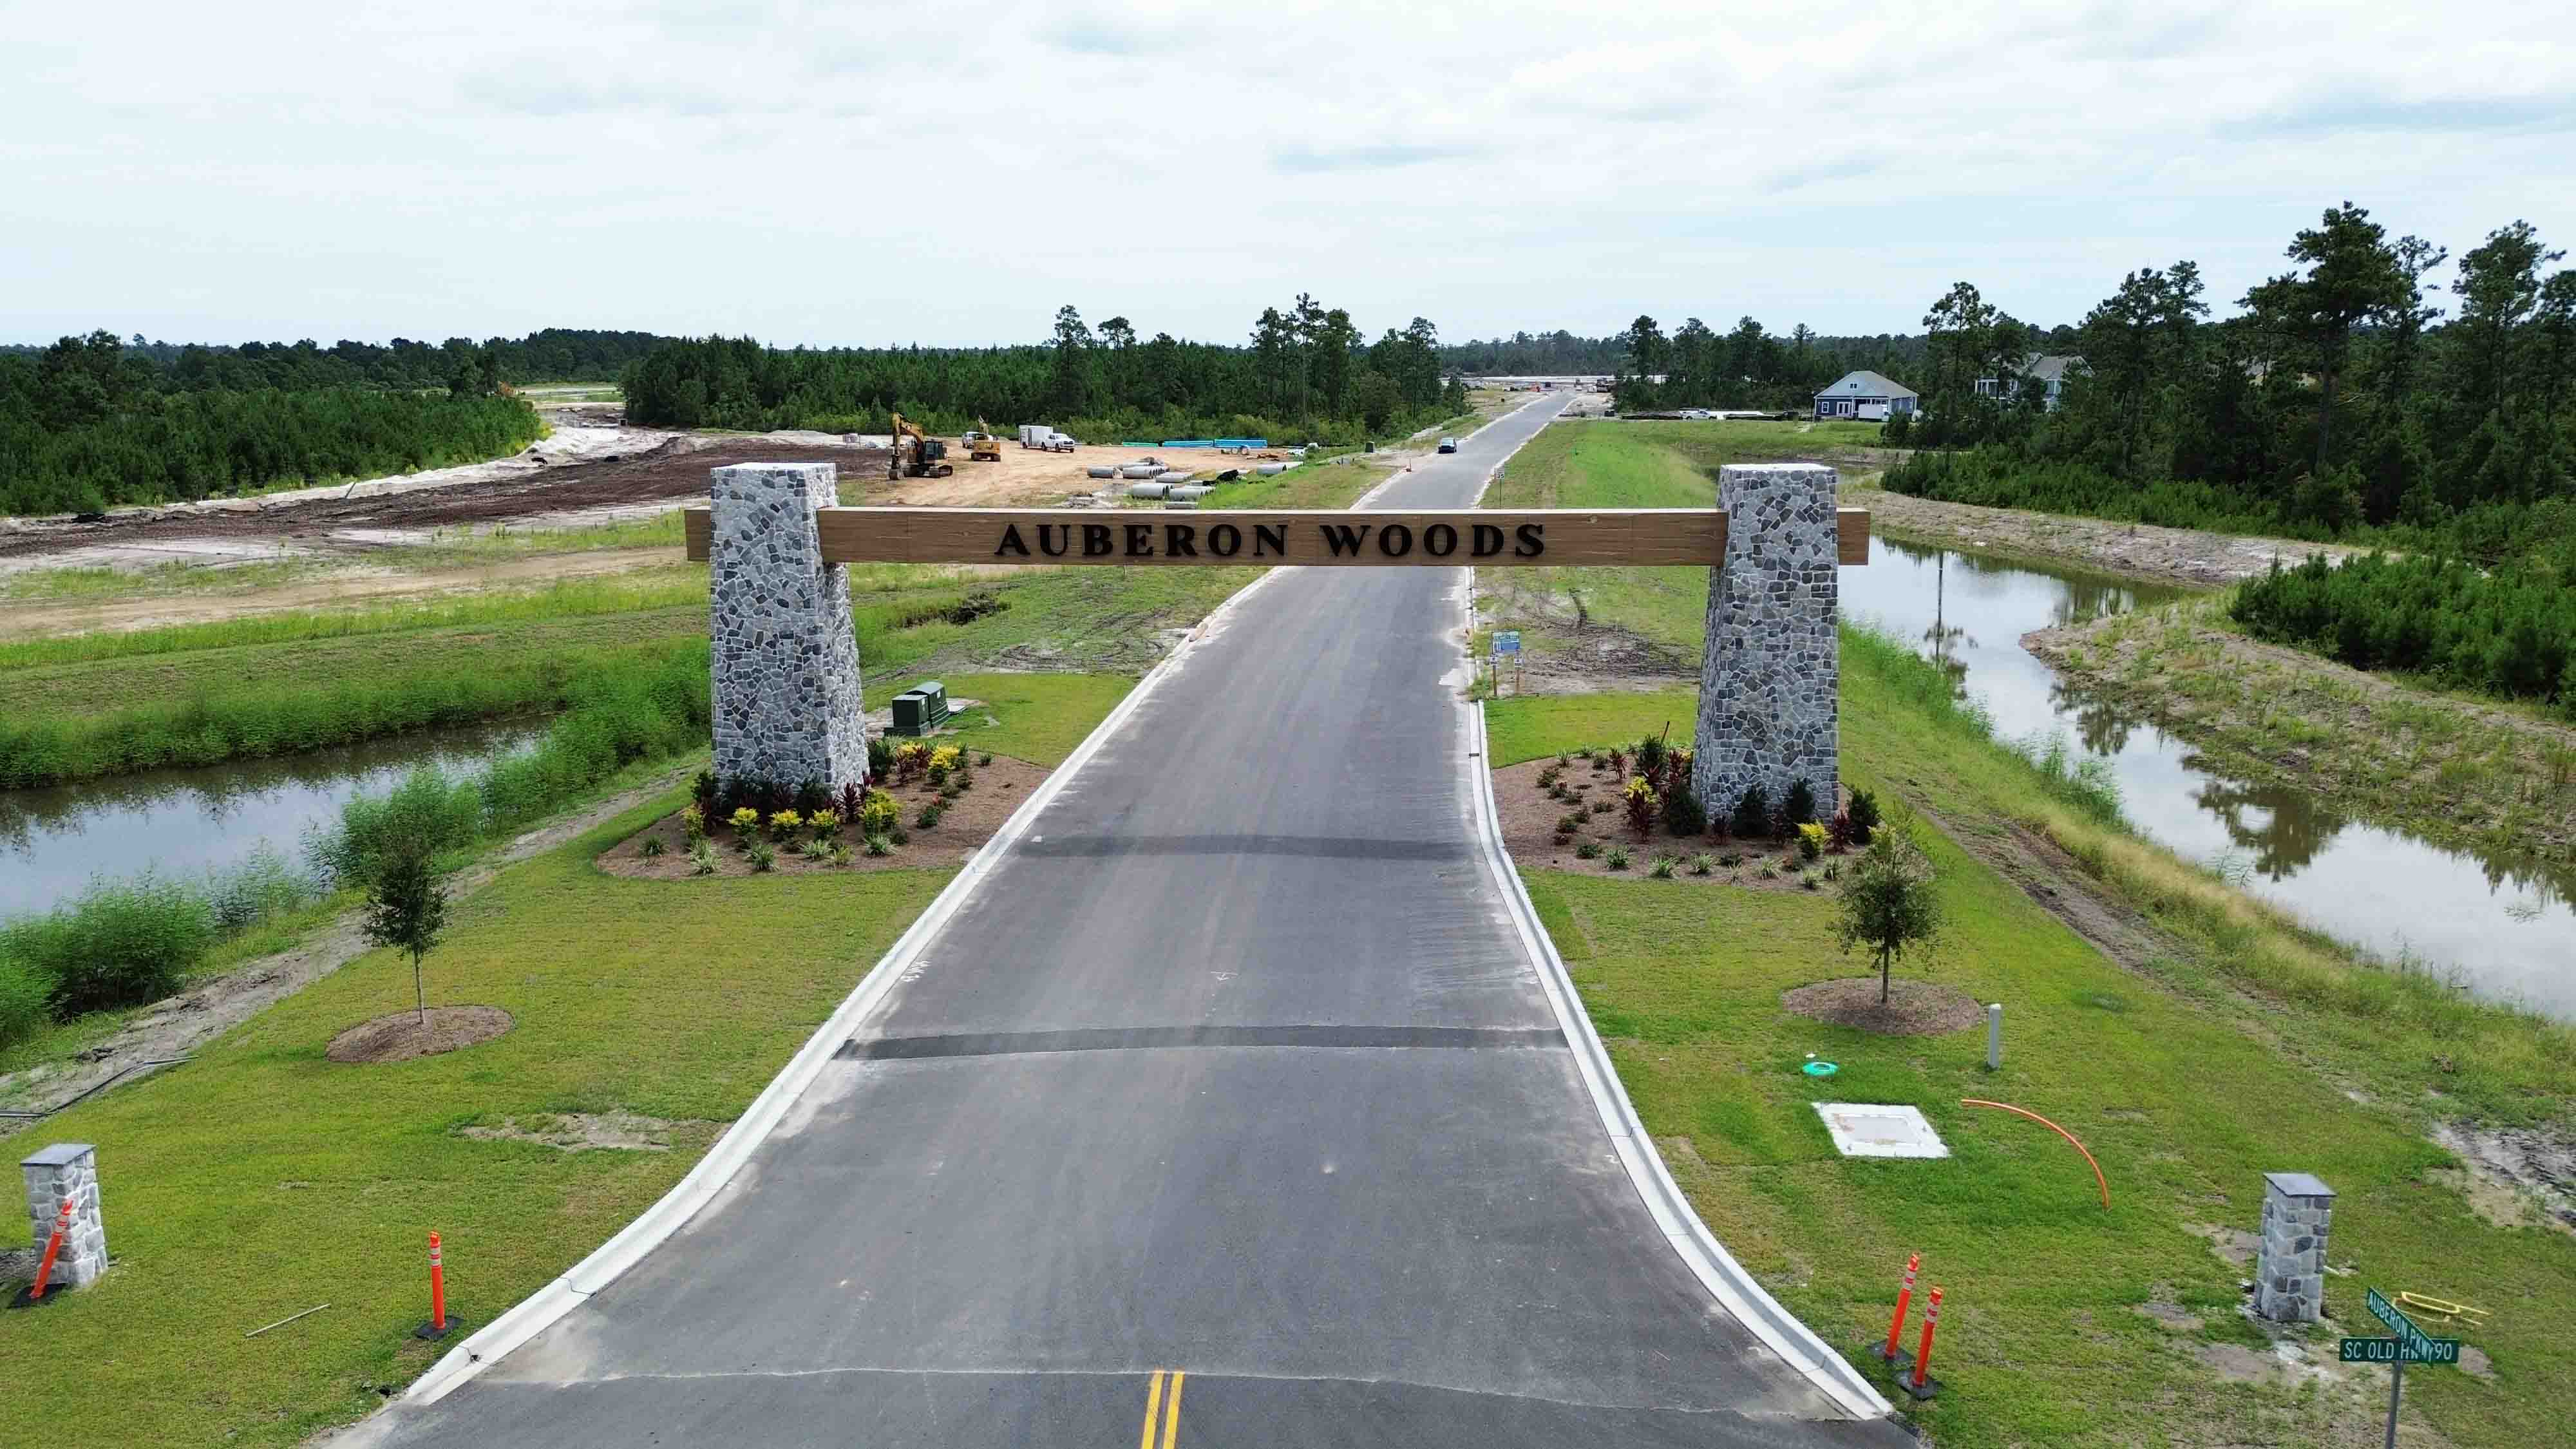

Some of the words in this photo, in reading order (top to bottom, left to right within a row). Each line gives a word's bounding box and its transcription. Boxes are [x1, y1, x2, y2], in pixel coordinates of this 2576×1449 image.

[994, 524, 1288, 556] AUBERON
[1319, 524, 1544, 557] WOODS
[2367, 1291, 2409, 1340] AUBERON
[2409, 1328, 2433, 1363] PKWY
[2344, 1341, 2362, 1359] SC
[2367, 1341, 2394, 1359] OLD
[2434, 1342, 2452, 1359] 90
